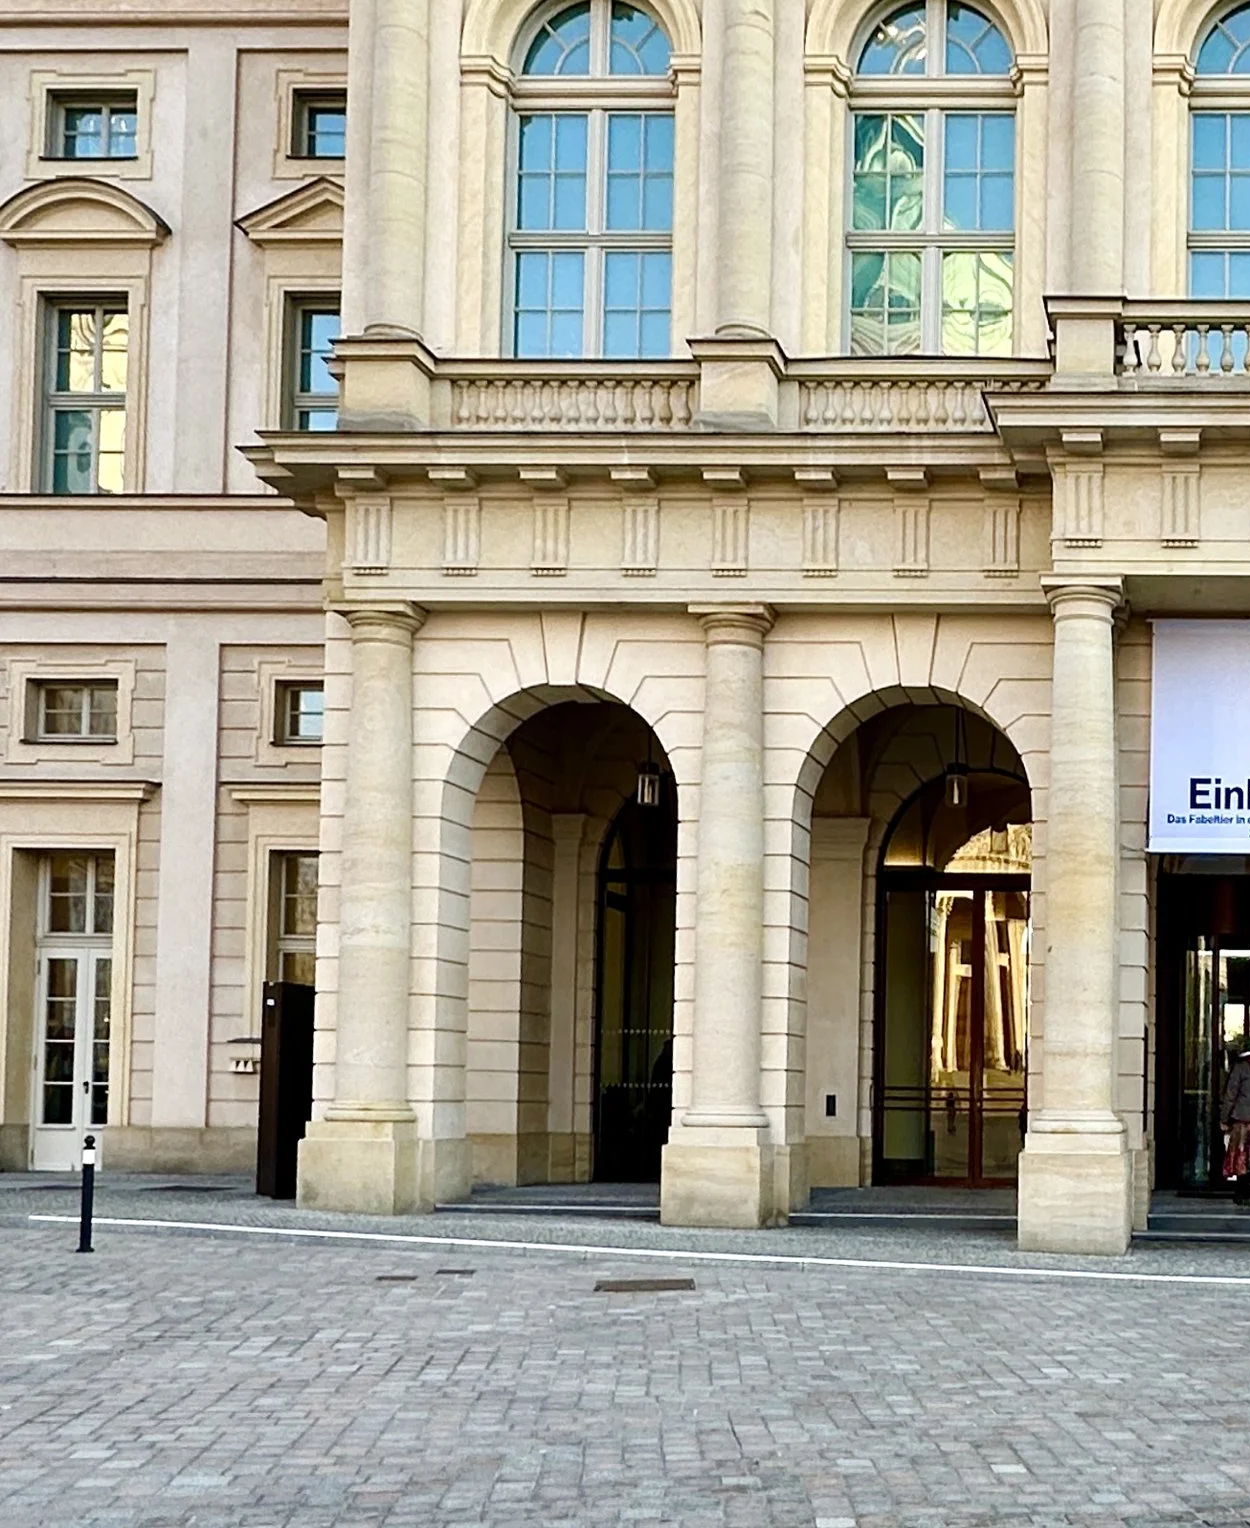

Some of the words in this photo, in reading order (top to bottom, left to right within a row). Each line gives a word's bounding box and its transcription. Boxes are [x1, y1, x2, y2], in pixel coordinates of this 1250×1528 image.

[1167, 814, 1187, 824] Das
[1189, 814, 1233, 824] Fabeltier
[1236, 814, 1245, 824] in
